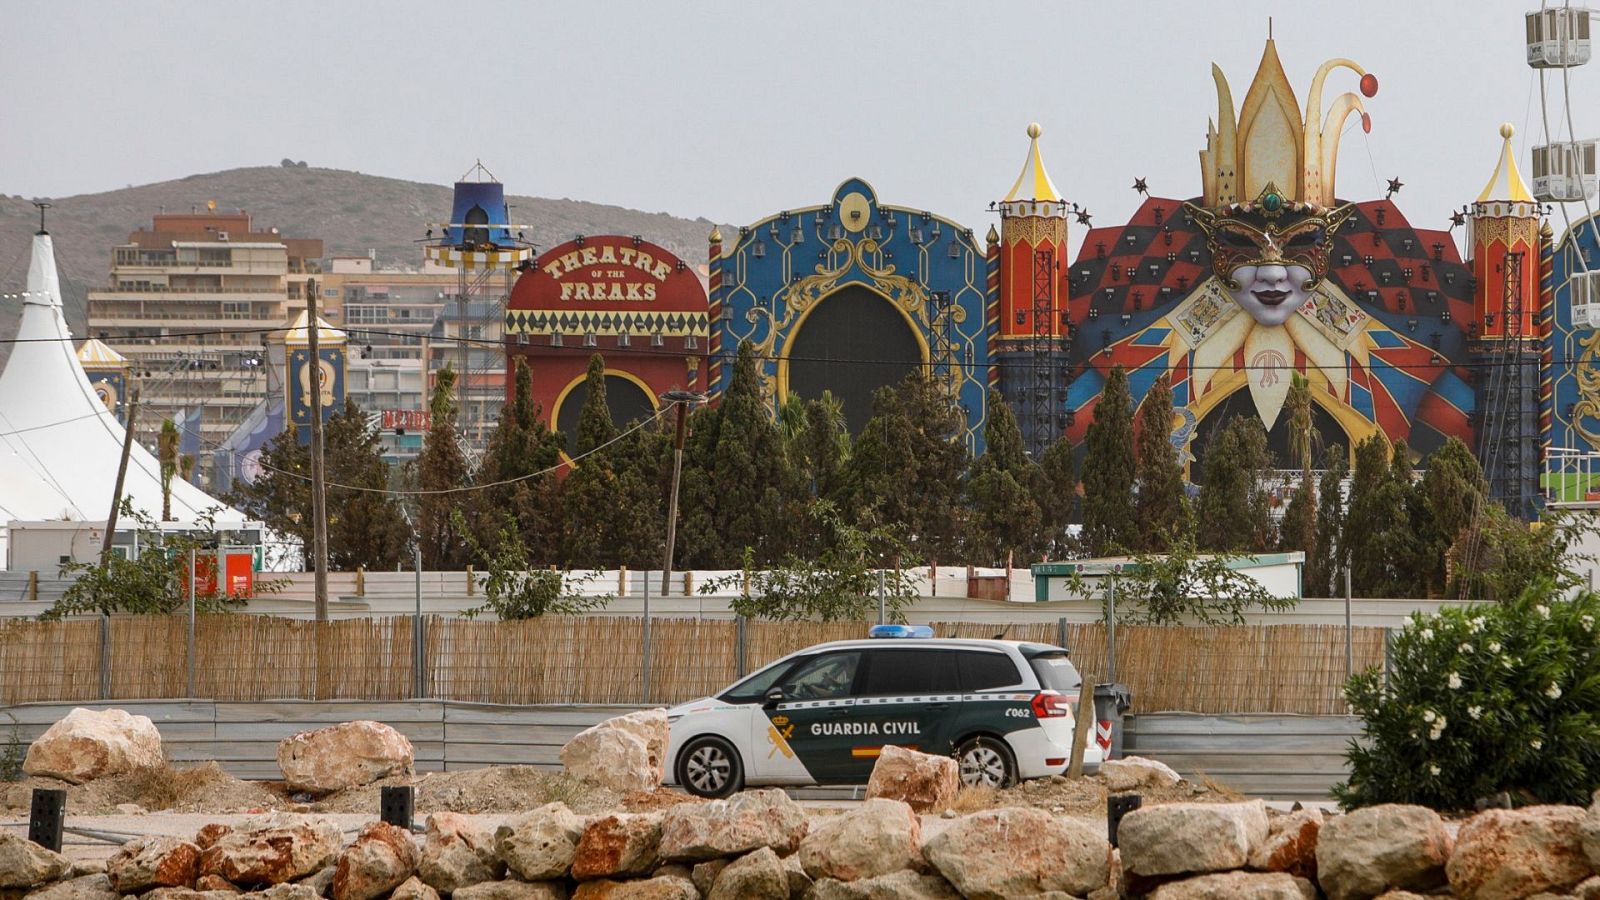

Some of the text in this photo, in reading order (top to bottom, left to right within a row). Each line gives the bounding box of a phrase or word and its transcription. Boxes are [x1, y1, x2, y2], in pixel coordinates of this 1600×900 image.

[543, 246, 672, 282] THEATRE
[591, 270, 625, 278] OF THE
[560, 282, 656, 301] FREAKS
[1011, 708, 1030, 718] 062
[810, 721, 921, 736] GUARDIA CIVIL
